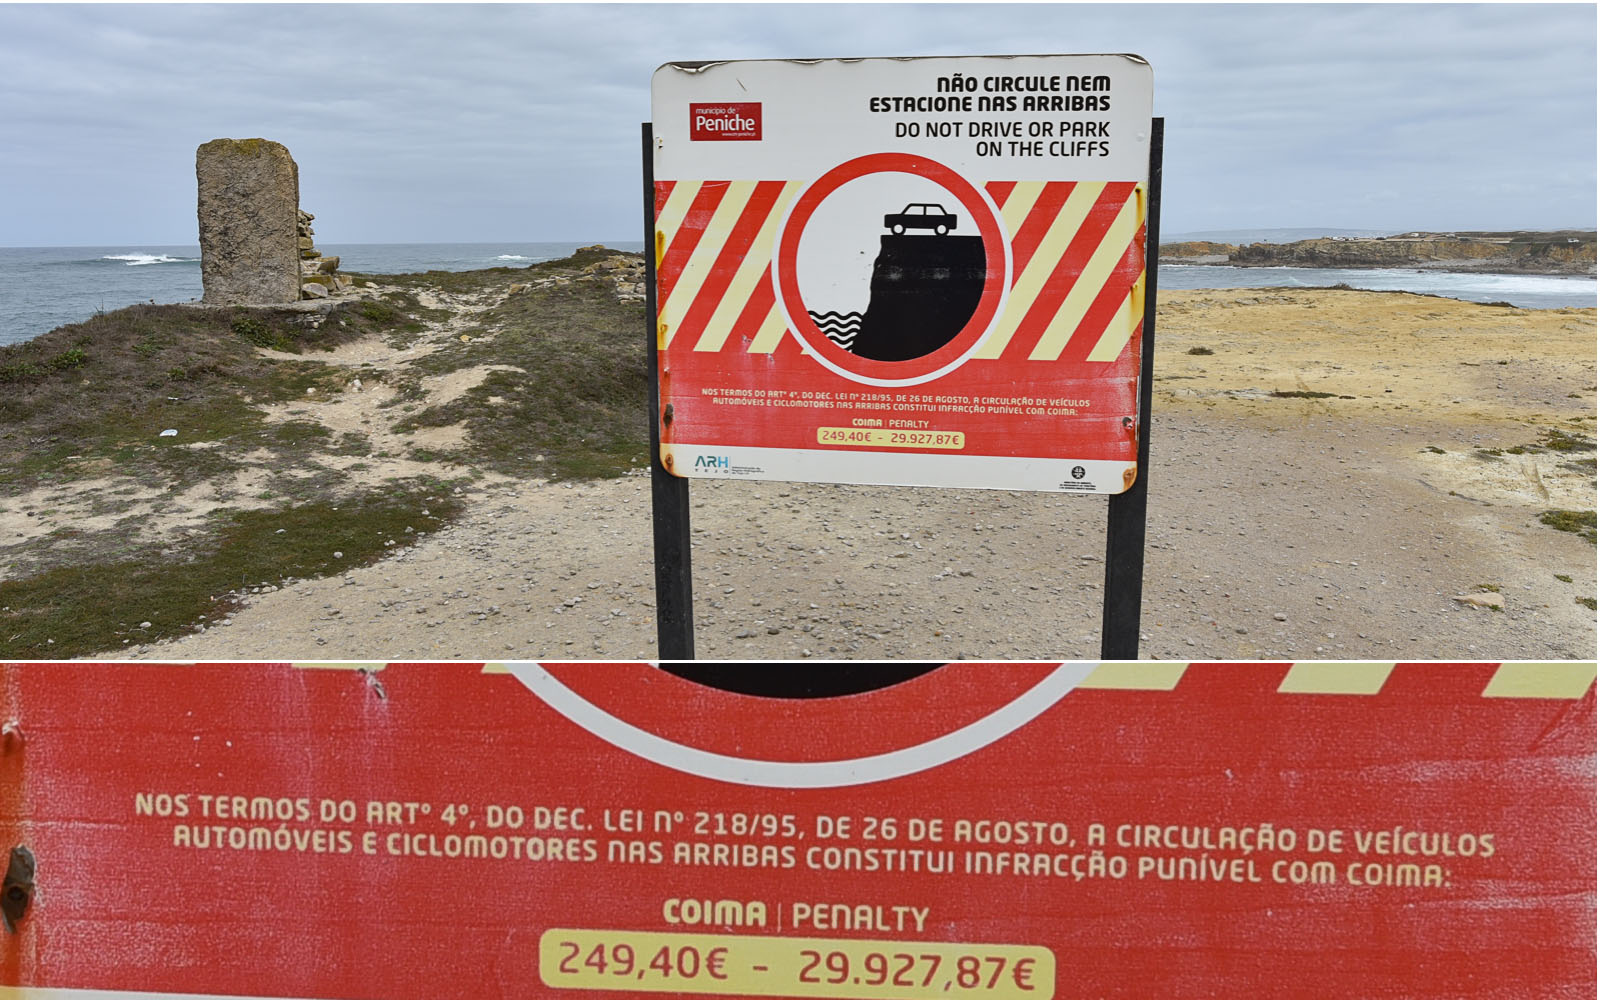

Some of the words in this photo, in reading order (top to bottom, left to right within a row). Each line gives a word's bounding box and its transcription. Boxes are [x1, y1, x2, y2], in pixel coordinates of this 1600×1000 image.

[936, 73, 978, 93] NÃO
[984, 76, 1060, 92] CIRCULE
[1066, 75, 1111, 92] NEM
[870, 96, 973, 113] ESTACIONE
[978, 96, 1017, 112] NAS
[1023, 95, 1111, 112] ARRIBAS
[696, 113, 755, 131] Peniche
[895, 122, 920, 138] DO
[926, 122, 963, 138] NOT
[968, 121, 1022, 138] DRIVE
[1028, 121, 1053, 138] OR
[1060, 121, 1111, 137] PARK
[976, 141, 1002, 157] ON
[1008, 141, 1043, 157] THE
[1049, 141, 1110, 157] CLIFFS
[702, 388, 719, 396] NOS
[720, 389, 752, 397] TERMOS
[754, 390, 766, 398] DO
[802, 391, 813, 399] DO
[815, 392, 833, 400] DEC.
[835, 392, 847, 400] LEI
[896, 394, 907, 402] DE
[909, 395, 920, 403] 26
[922, 395, 933, 403] DE
[935, 396, 971, 404] AGOSTO,
[973, 396, 979, 404] A
[981, 395, 1034, 406] CIRCULAÇÃO
[1036, 398, 1048, 406] DE
[1050, 397, 1090, 407] VEÍCULOS
[712, 396, 764, 406] AUTOMÓVEIS
[766, 398, 772, 406] E
[773, 398, 835, 409] CICLOMOTORES
[836, 401, 853, 409] NAS
[855, 401, 890, 410] ARRIBAS
[893, 403, 936, 412] CONSTITUI
[938, 403, 985, 414] INFRACÇÃO
[988, 405, 1024, 415] PUNÍVEL
[1026, 407, 1045, 415] COM
[1047, 408, 1078, 416] COIMA:
[852, 418, 882, 427] COIMA
[889, 419, 929, 428] PENALTY
[822, 430, 871, 443] 249,40€
[890, 432, 959, 445] 29.927,87€
[695, 456, 728, 468] ARH
[135, 792, 189, 817] NOS
[198, 794, 310, 822] TERMOS
[319, 798, 356, 823] DO
[486, 805, 524, 829] DO
[533, 806, 593, 831] DEC.
[603, 809, 642, 833] LEI
[694, 811, 805, 840] 218/95,
[816, 815, 851, 840] DE
[862, 816, 897, 841] 26
[908, 818, 943, 842] DE
[954, 819, 1076, 848] AGOSTO,
[1088, 823, 1105, 847] A
[1116, 822, 1296, 855] CIRCULAÇÃO
[1307, 829, 1343, 853] DE
[1353, 825, 1495, 858] VEÍCULOS
[173, 822, 353, 854] AUTOMÓVEIS
[362, 831, 377, 855] E
[386, 832, 597, 862] CICLOMOTORES
[608, 839, 663, 864] NAS
[673, 842, 796, 868] ARRIBAS
[805, 846, 953, 873] CONSTITUI
[965, 850, 1127, 882] INFRACÇÃO
[1138, 852, 1261, 884] PUNÍVEL
[1272, 859, 1336, 885] COM
[1346, 862, 1451, 888] COIMA:
[663, 897, 766, 927] COIMA
[792, 901, 929, 932] PENALTY
[558, 941, 729, 981] 249,40€
[800, 950, 1036, 992] 29.927,87€
